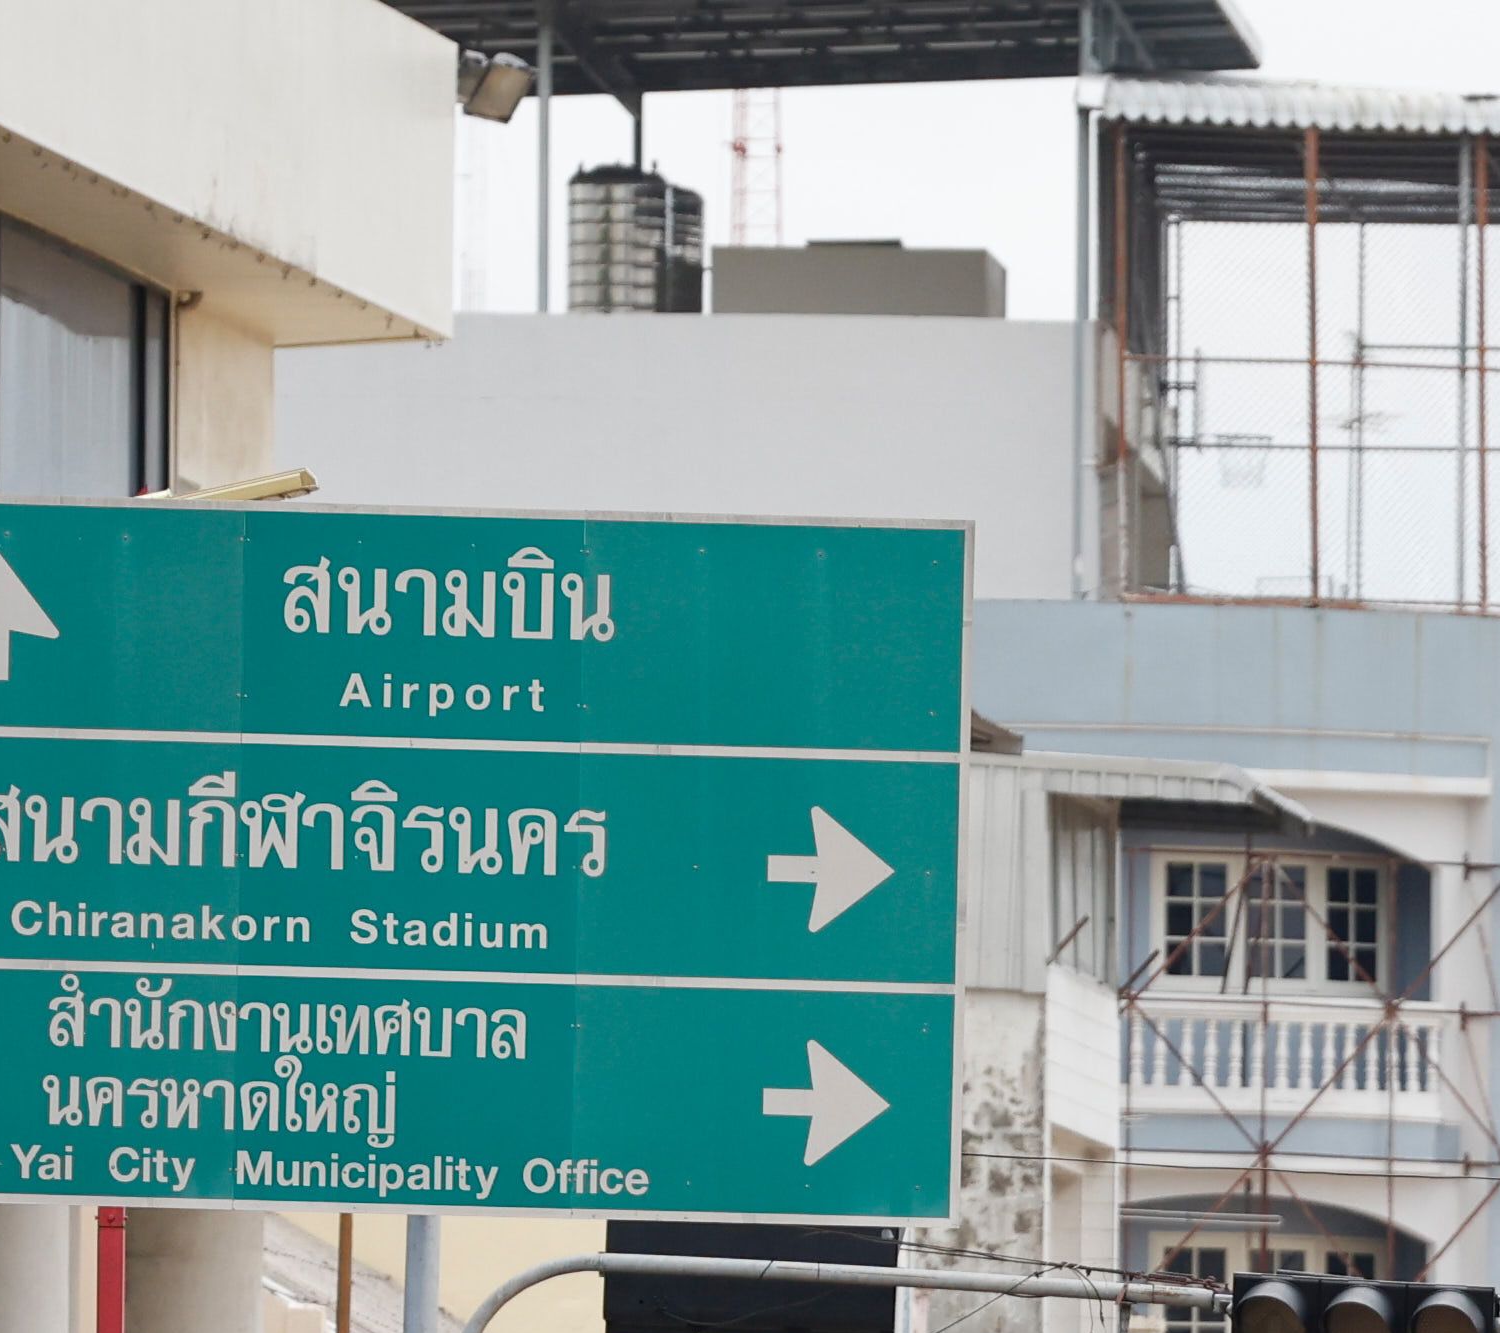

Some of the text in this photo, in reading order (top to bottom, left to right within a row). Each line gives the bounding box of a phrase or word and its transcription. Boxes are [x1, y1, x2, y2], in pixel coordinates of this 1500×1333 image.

[283, 546, 615, 642] สนามบิน
[340, 673, 544, 717] Airport
[11, 900, 547, 949] Chiranakorn Stadium
[47, 972, 527, 1060] สำนักงานเทศบาล
[43, 1053, 396, 1149] นครหาดใหญ่
[11, 1144, 73, 1180] Yai
[109, 1147, 195, 1191] City
[236, 1150, 498, 1199] Municipality
[523, 1157, 648, 1196] Office
